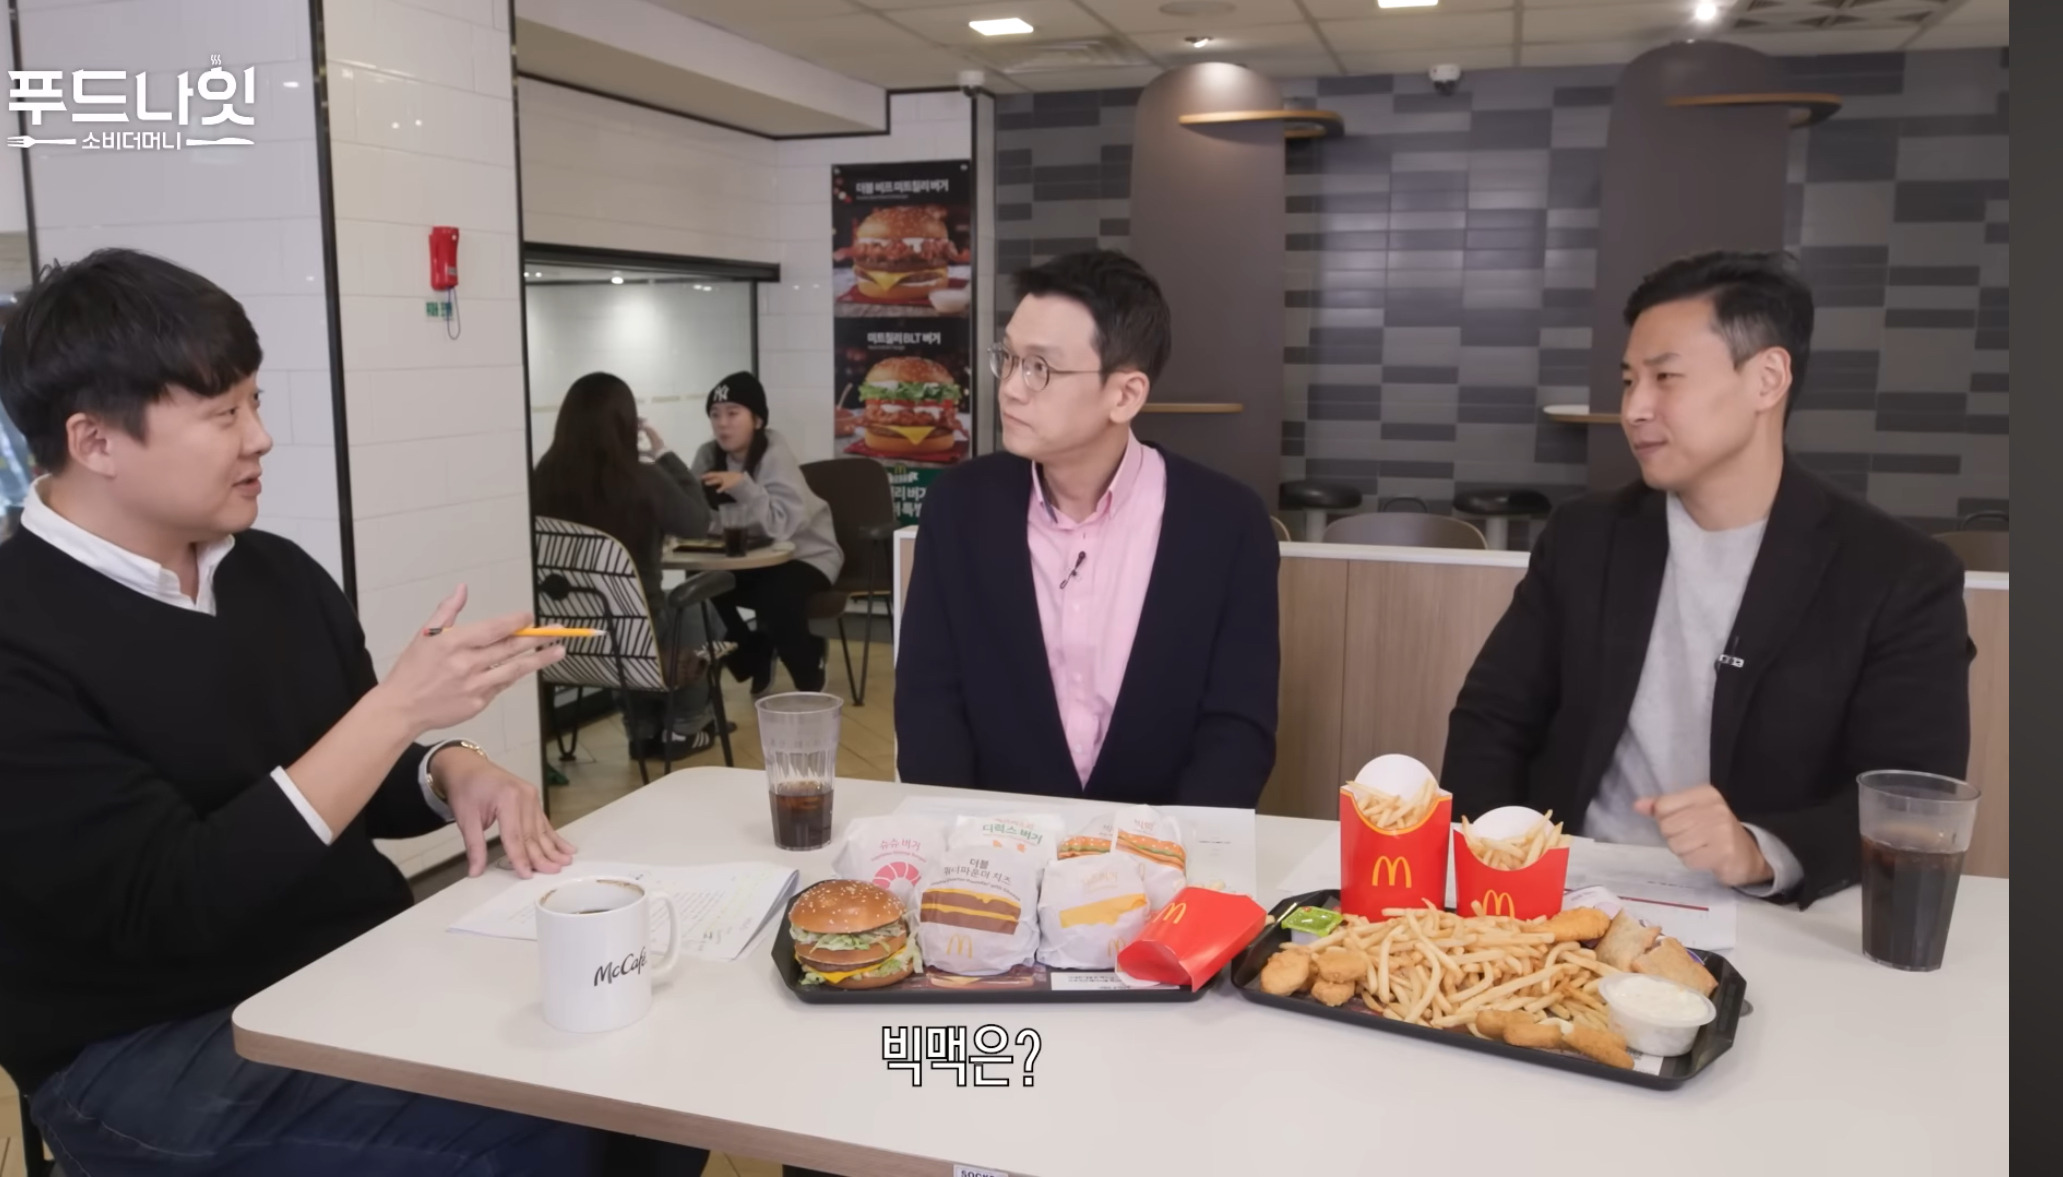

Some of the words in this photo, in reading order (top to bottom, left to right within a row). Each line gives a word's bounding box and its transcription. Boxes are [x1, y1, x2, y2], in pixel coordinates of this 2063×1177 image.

[930, 178, 949, 193] 버거
[922, 332, 941, 345] 버거
[901, 838, 921, 851] 버거
[1020, 829, 1043, 845] 버거
[970, 858, 990, 870] 더블
[993, 871, 1012, 886] 치즈
[594, 946, 647, 987] McCafé
